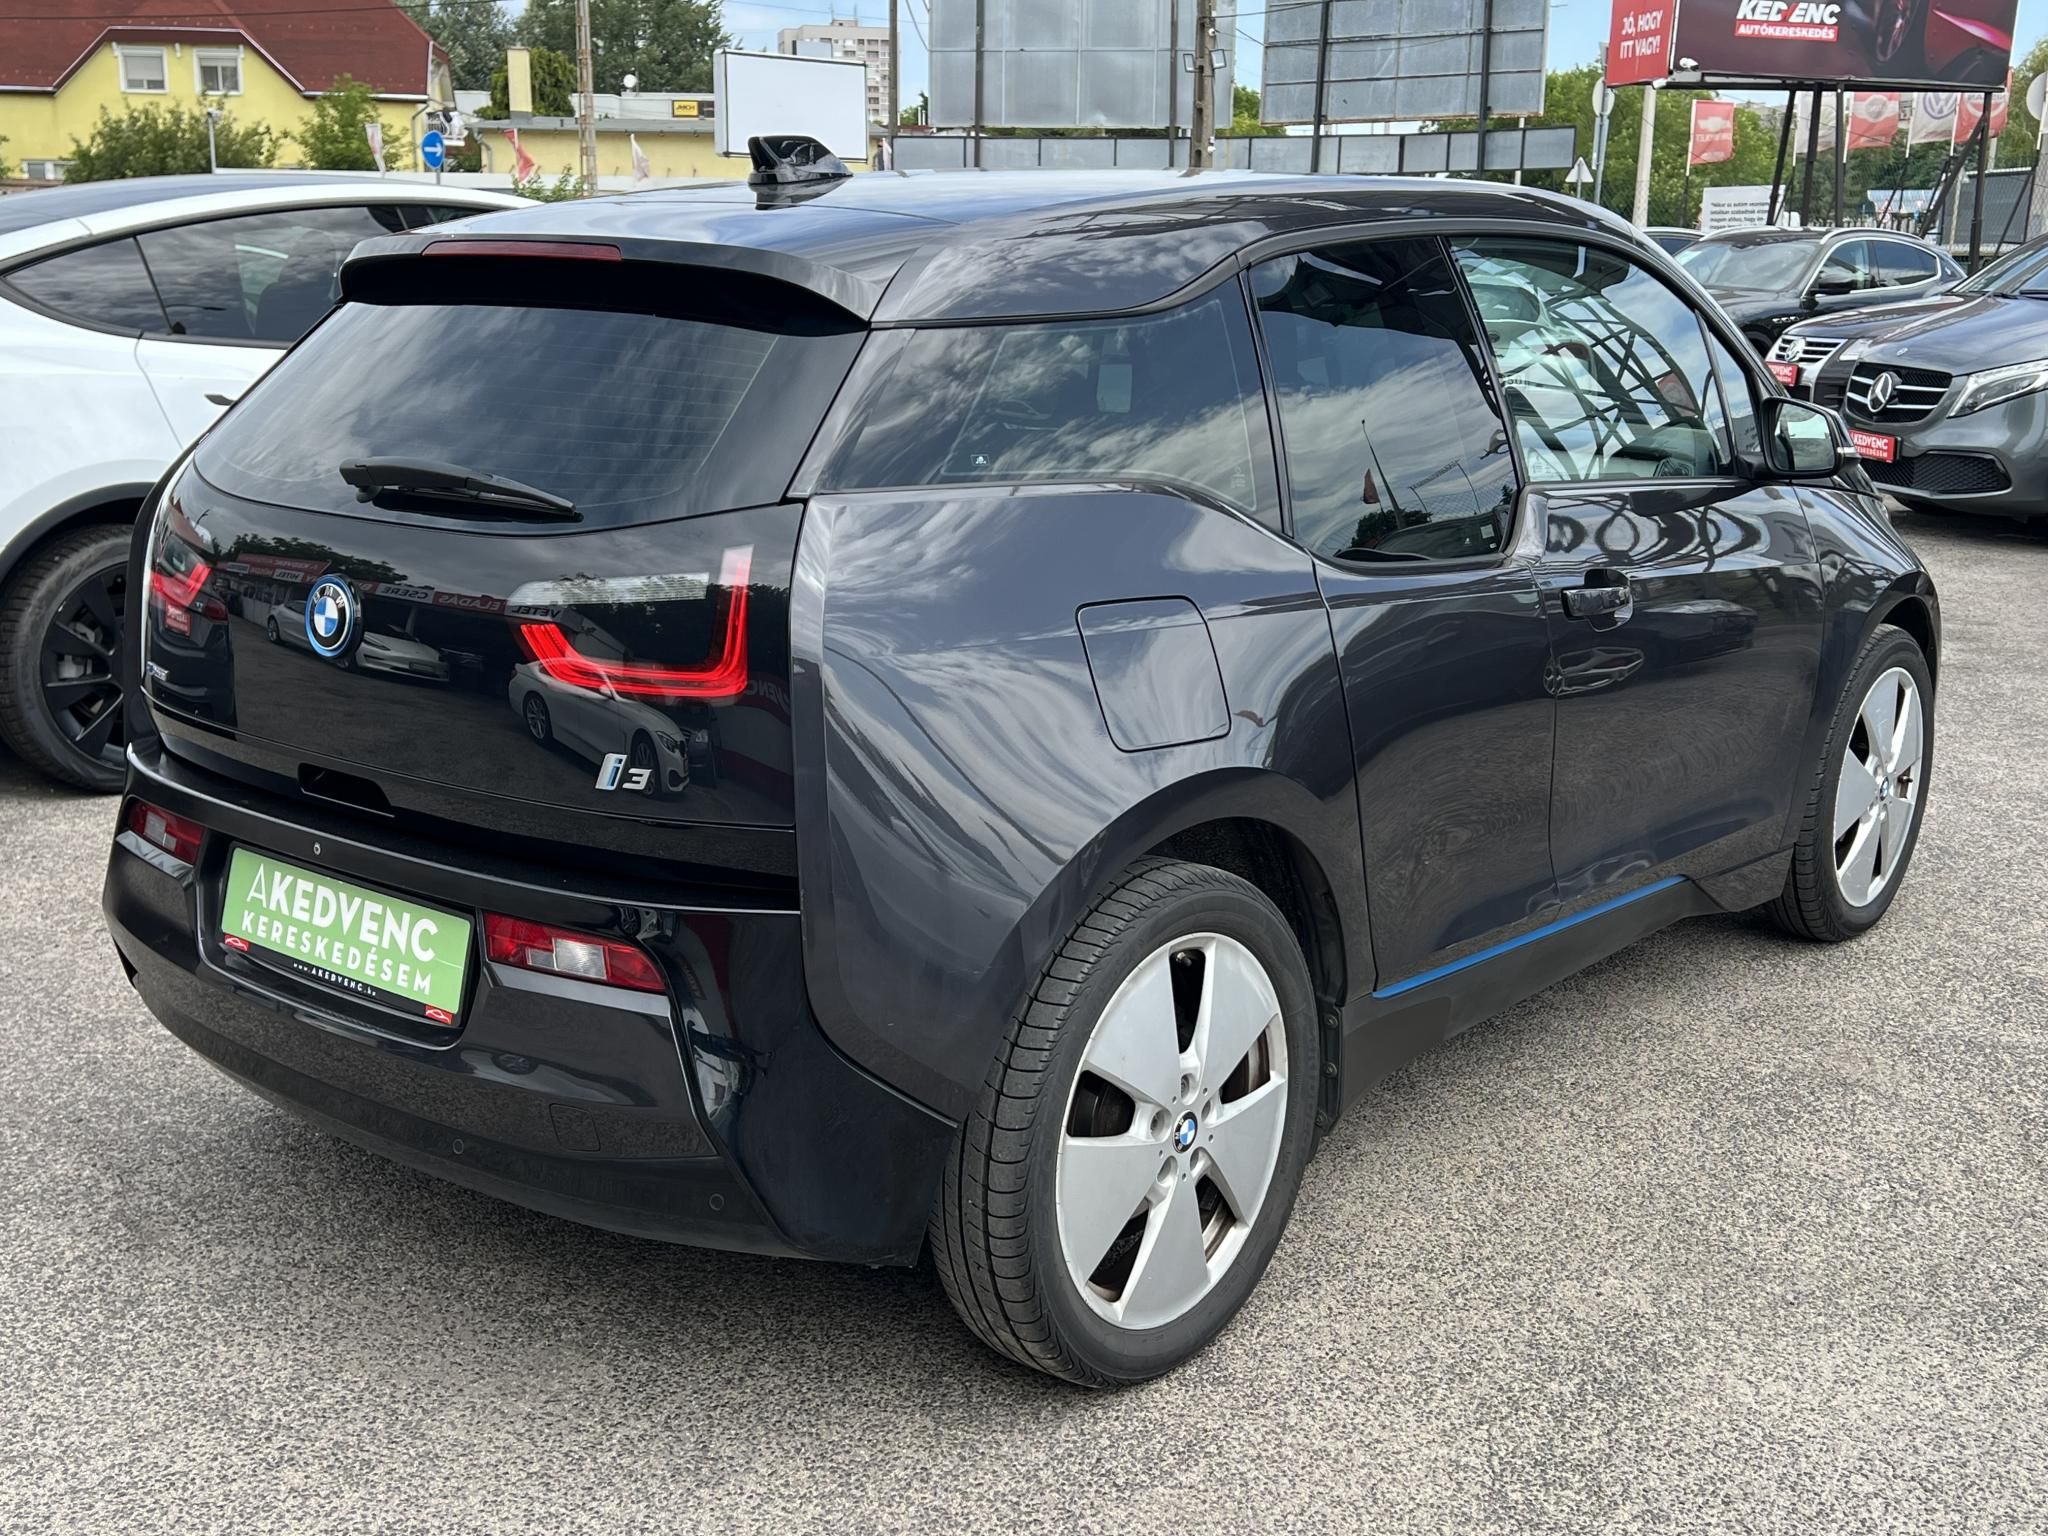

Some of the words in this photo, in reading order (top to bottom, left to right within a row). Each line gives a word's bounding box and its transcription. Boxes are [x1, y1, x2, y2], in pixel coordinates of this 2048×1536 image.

[1621, 11, 1636, 37] JÓ,
[1637, 9, 1663, 32] HOGY
[1738, 23, 1835, 39] AUTÓKERESKEDÉS
[1620, 40, 1634, 59] ITT
[1635, 35, 1661, 57] VAGY!
[595, 753, 653, 790] i3
[247, 863, 438, 962] AKEDVENC
[241, 910, 432, 995] KERESKEDÉSEM
